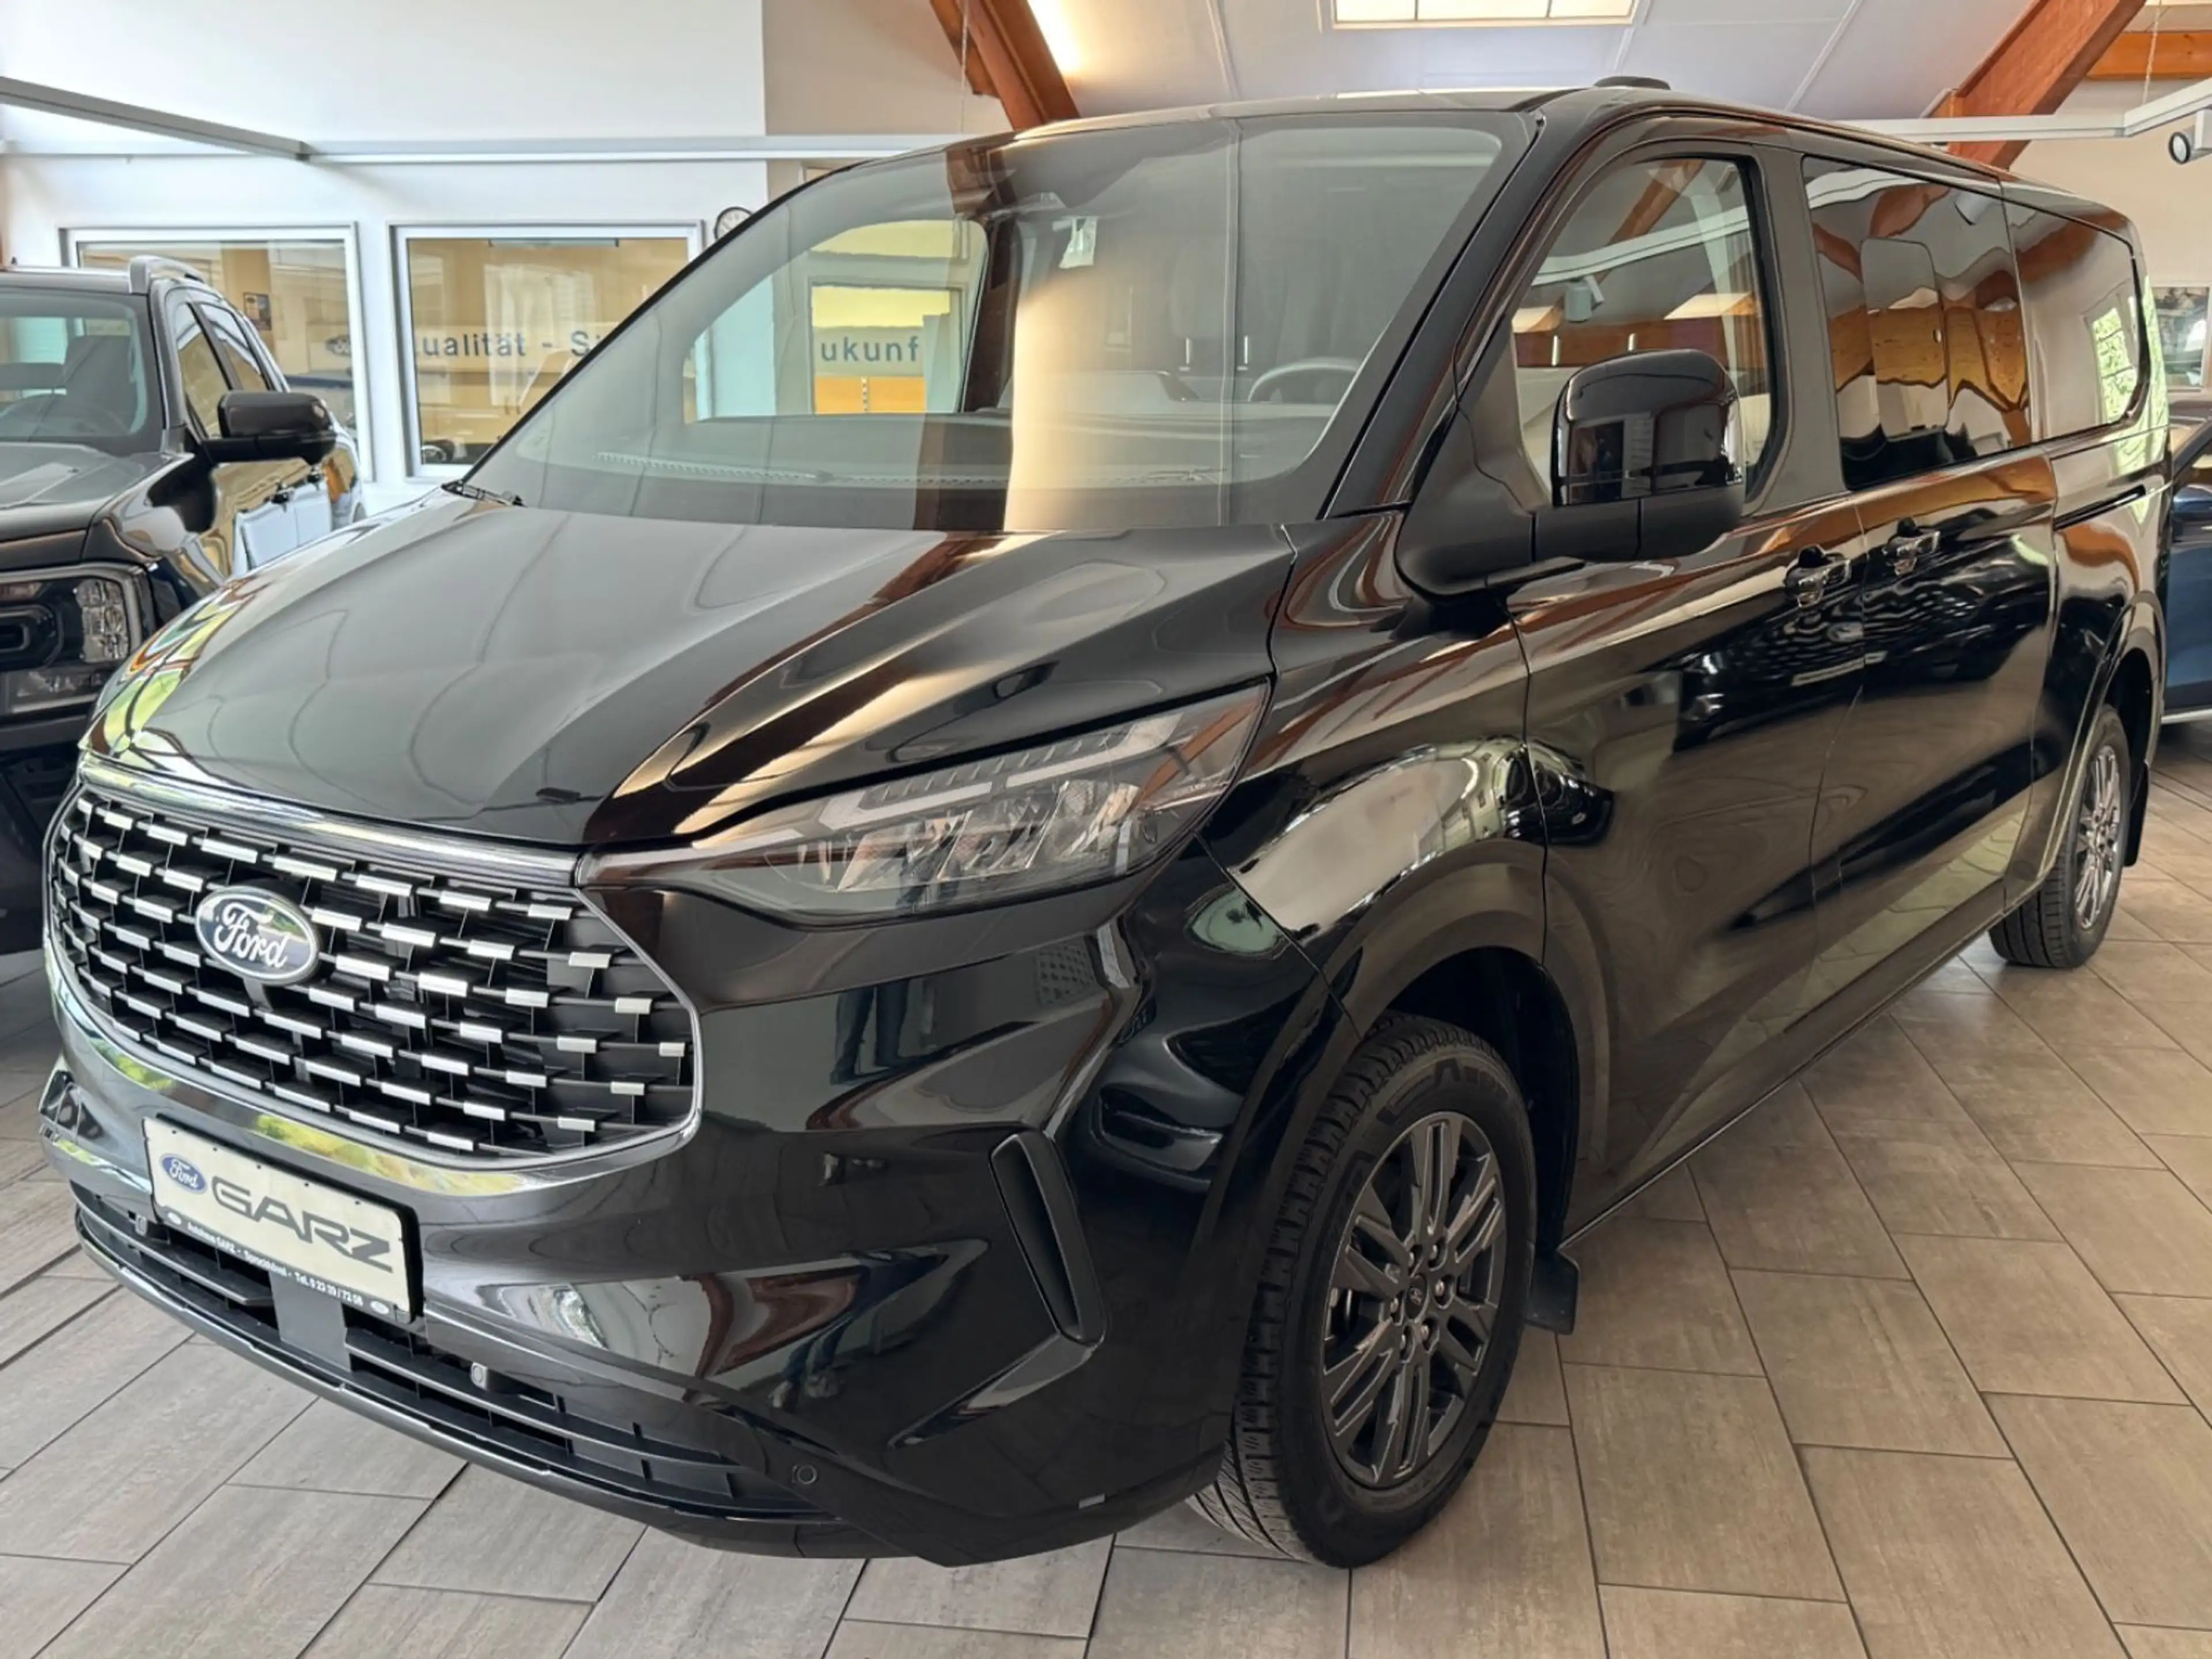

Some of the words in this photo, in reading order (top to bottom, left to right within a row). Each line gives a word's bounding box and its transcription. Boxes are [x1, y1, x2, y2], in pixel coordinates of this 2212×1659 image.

[422, 332, 527, 357] ualität
[570, 330, 601, 358] S
[821, 336, 919, 362] ukunf
[214, 902, 289, 968] Ford
[169, 1158, 199, 1189] Ford
[211, 1176, 393, 1273] GARZ
